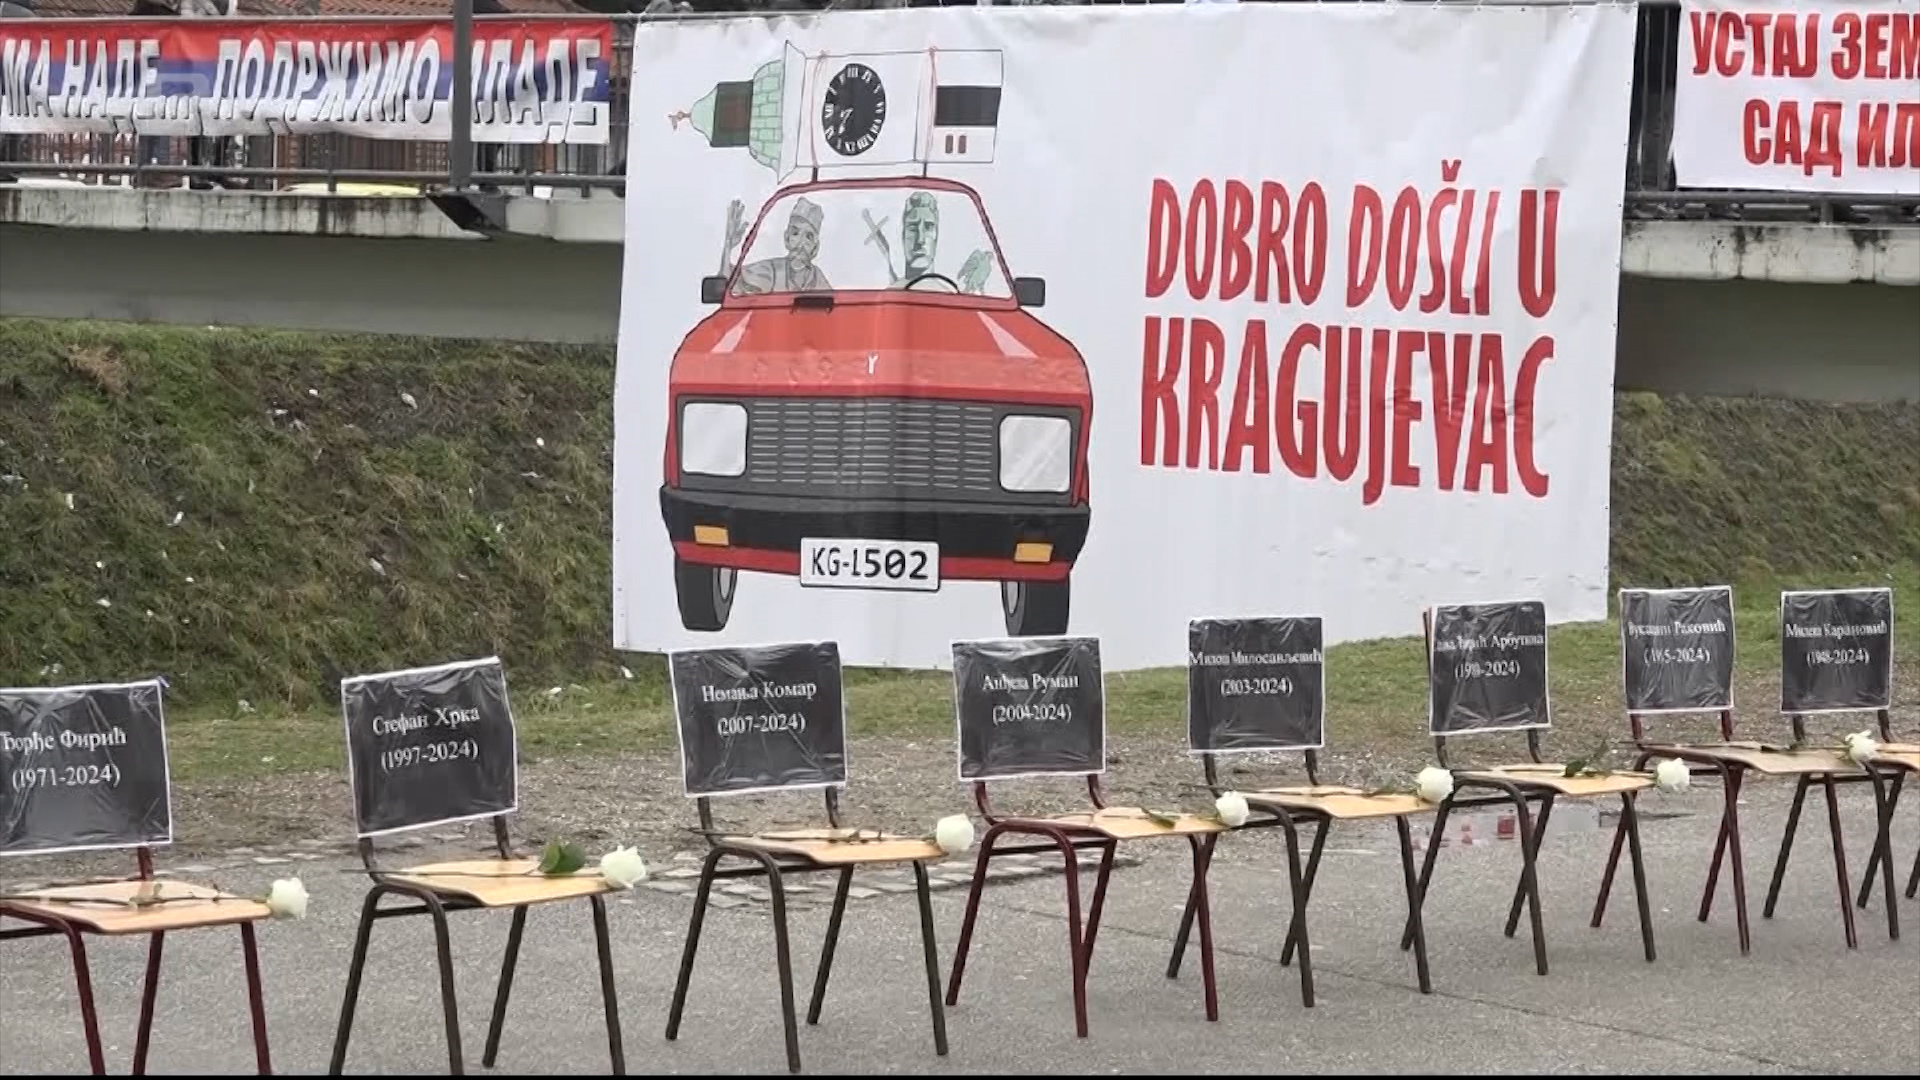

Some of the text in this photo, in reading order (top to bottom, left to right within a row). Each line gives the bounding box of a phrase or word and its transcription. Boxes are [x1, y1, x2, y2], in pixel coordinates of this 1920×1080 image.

[1690, 11, 1920, 79] УСТАЈ ЗЕМ
[212, 38, 440, 134] ПОДРЖИМО
[1744, 99, 1920, 176] САД ИЛ
[1145, 159, 1560, 318] DOBRO DOŠLI U
[1141, 316, 1554, 506] KRAGUJEVAC
[811, 547, 929, 580] KG-1502
[763, 681, 817, 700] Комар
[1032, 673, 1079, 693] Руман
[372, 707, 481, 736] Стефан Хрка
[717, 712, 807, 736] (2007-2024)
[992, 703, 1072, 726] (2004-2024)
[60, 726, 127, 752] Фирић
[381, 739, 479, 773] (1997-2024)
[12, 763, 121, 793] (1971-2024)
